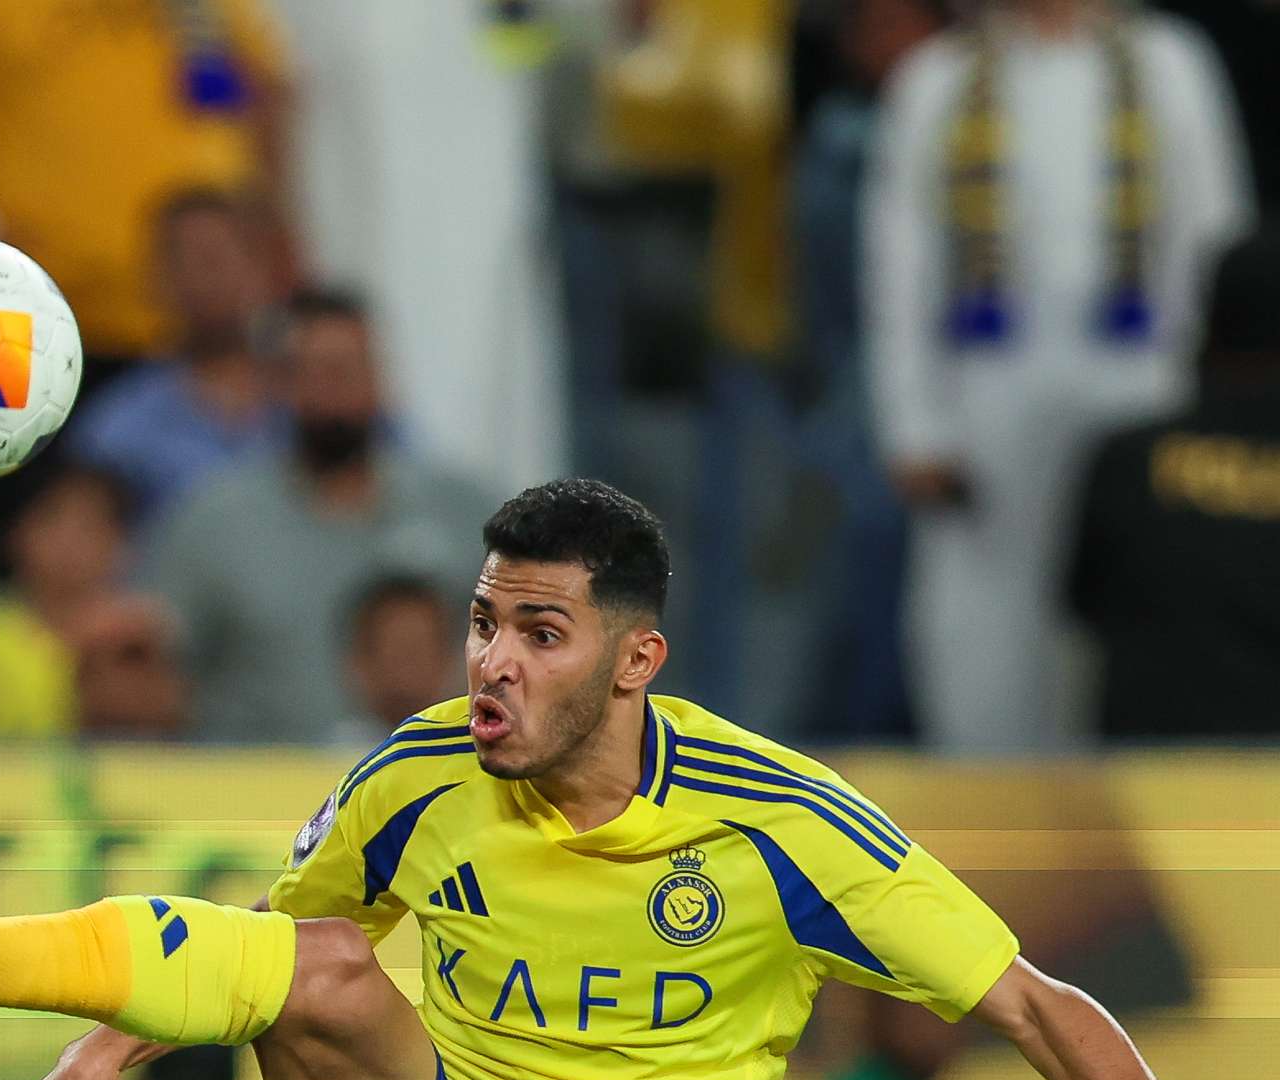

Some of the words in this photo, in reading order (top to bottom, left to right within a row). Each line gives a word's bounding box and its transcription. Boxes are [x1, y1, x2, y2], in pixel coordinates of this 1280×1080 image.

[661, 880, 676, 897] AL
[676, 876, 713, 898] NASSR
[660, 919, 694, 940] FOOTBALL
[695, 920, 711, 937] CLUB
[437, 935, 713, 1031] KAFD
